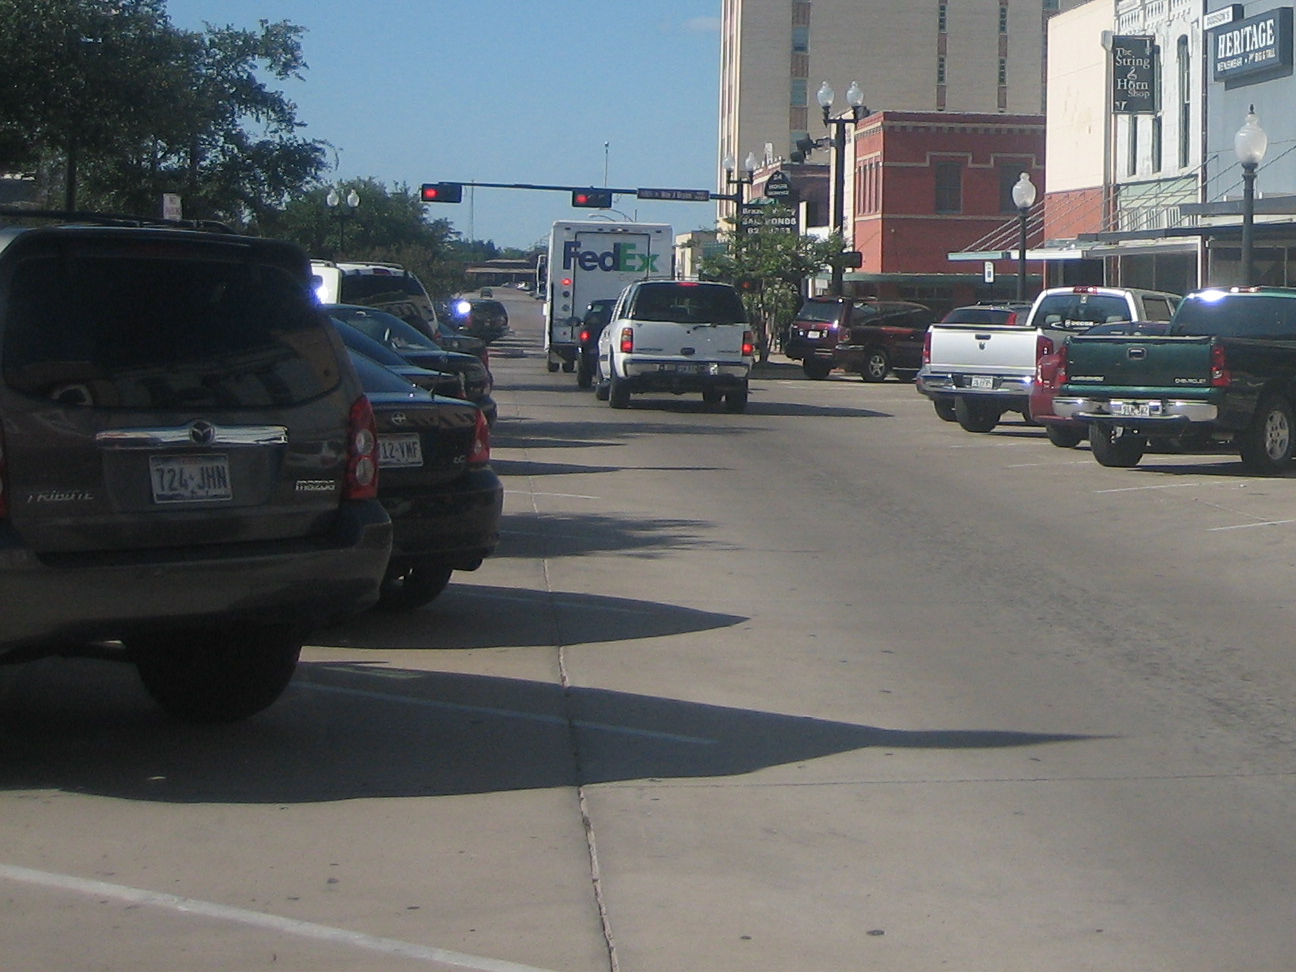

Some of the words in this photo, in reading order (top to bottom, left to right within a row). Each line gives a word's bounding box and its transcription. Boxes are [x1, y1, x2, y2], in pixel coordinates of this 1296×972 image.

[1217, 19, 1274, 59] HERITAGE
[1115, 48, 1132, 56] The
[1115, 55, 1150, 70] String
[1117, 78, 1149, 90] Horn
[1127, 89, 1150, 99] Shop
[563, 240, 660, 273] FedEx
